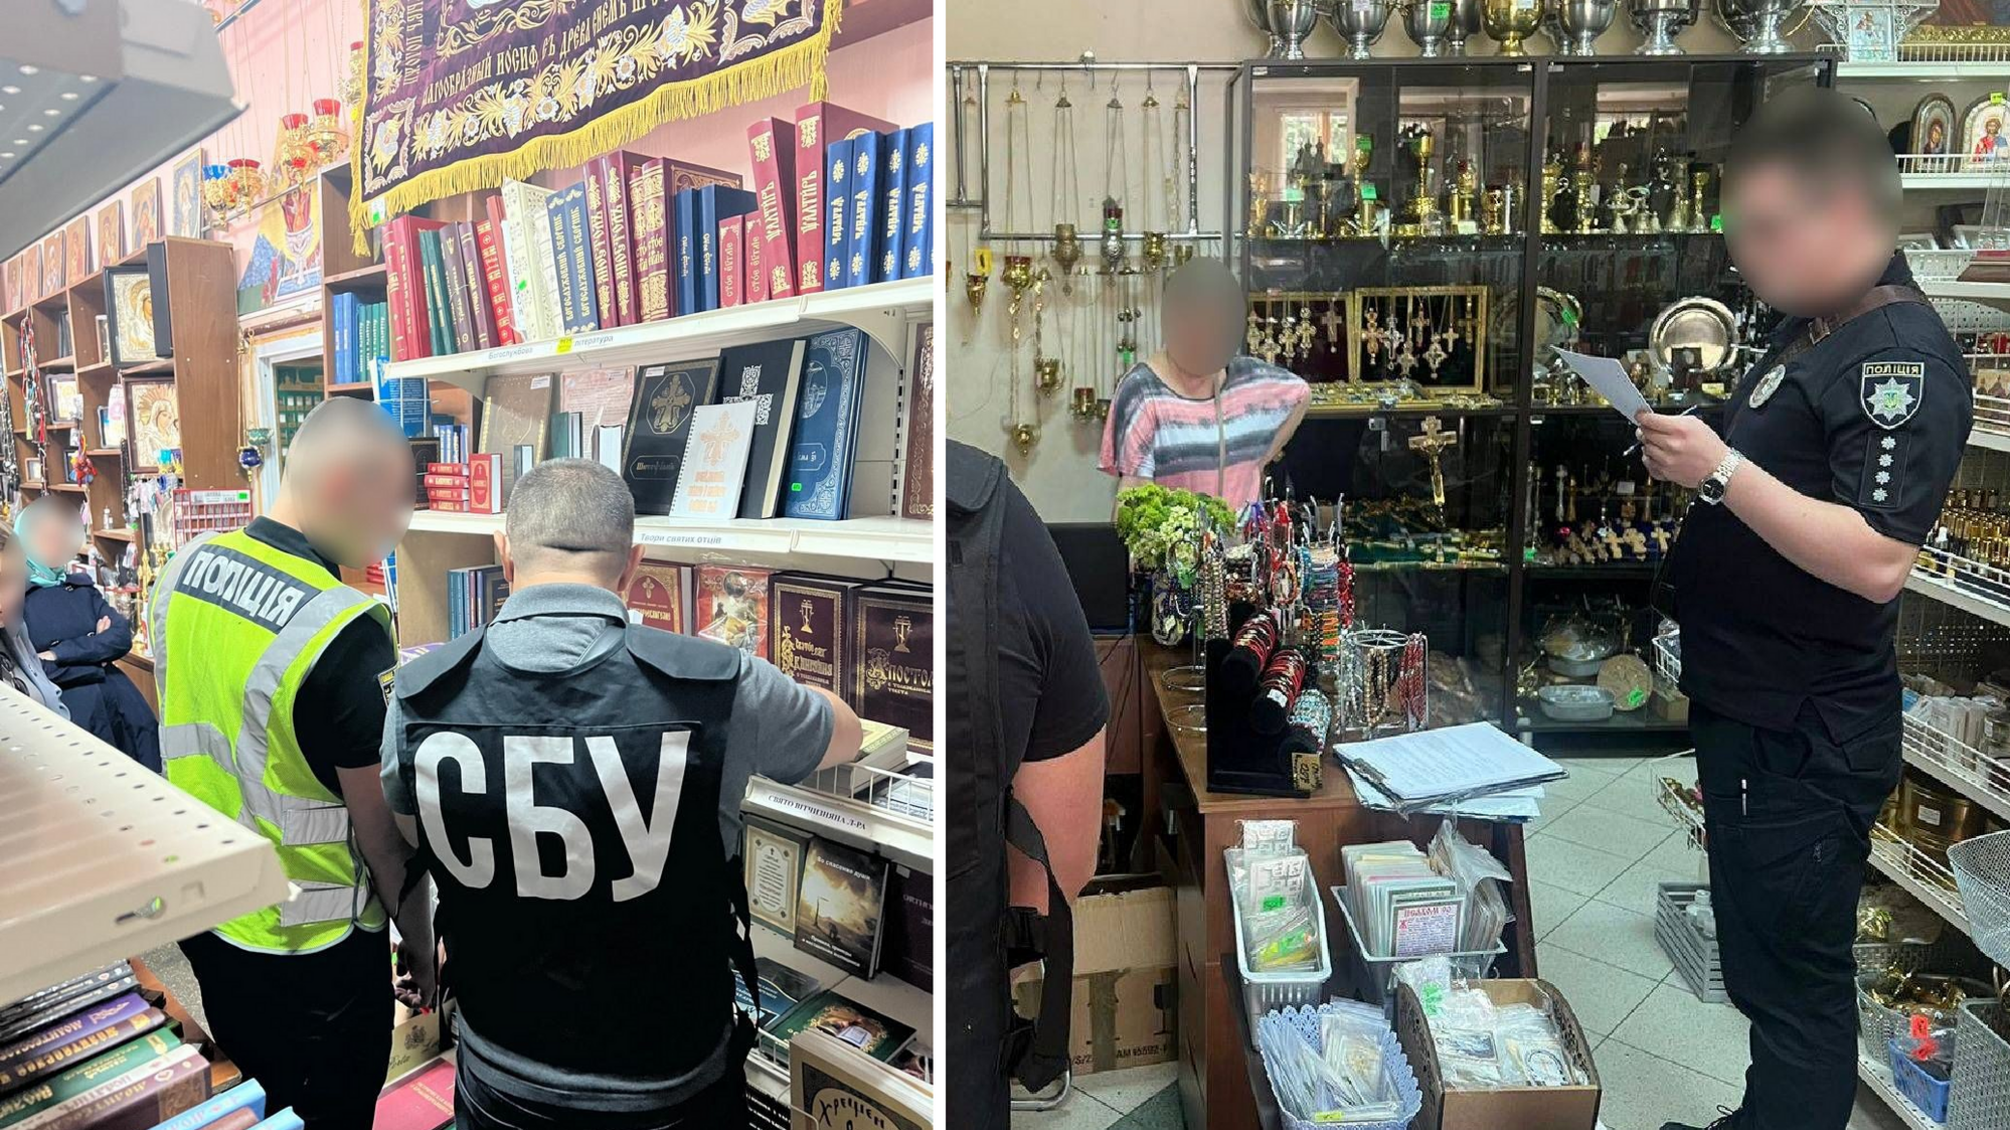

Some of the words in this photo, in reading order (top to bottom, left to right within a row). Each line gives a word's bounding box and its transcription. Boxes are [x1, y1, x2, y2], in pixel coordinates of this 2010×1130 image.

[1866, 364, 1919, 375] ПОЛІЦІЯ
[640, 533, 665, 544] Твори
[666, 535, 695, 545] святих
[696, 536, 722, 546] отців
[182, 551, 307, 627] ПОЛІЦІЯ
[768, 794, 794, 808] СВЯТО
[413, 730, 692, 902] СБУ
